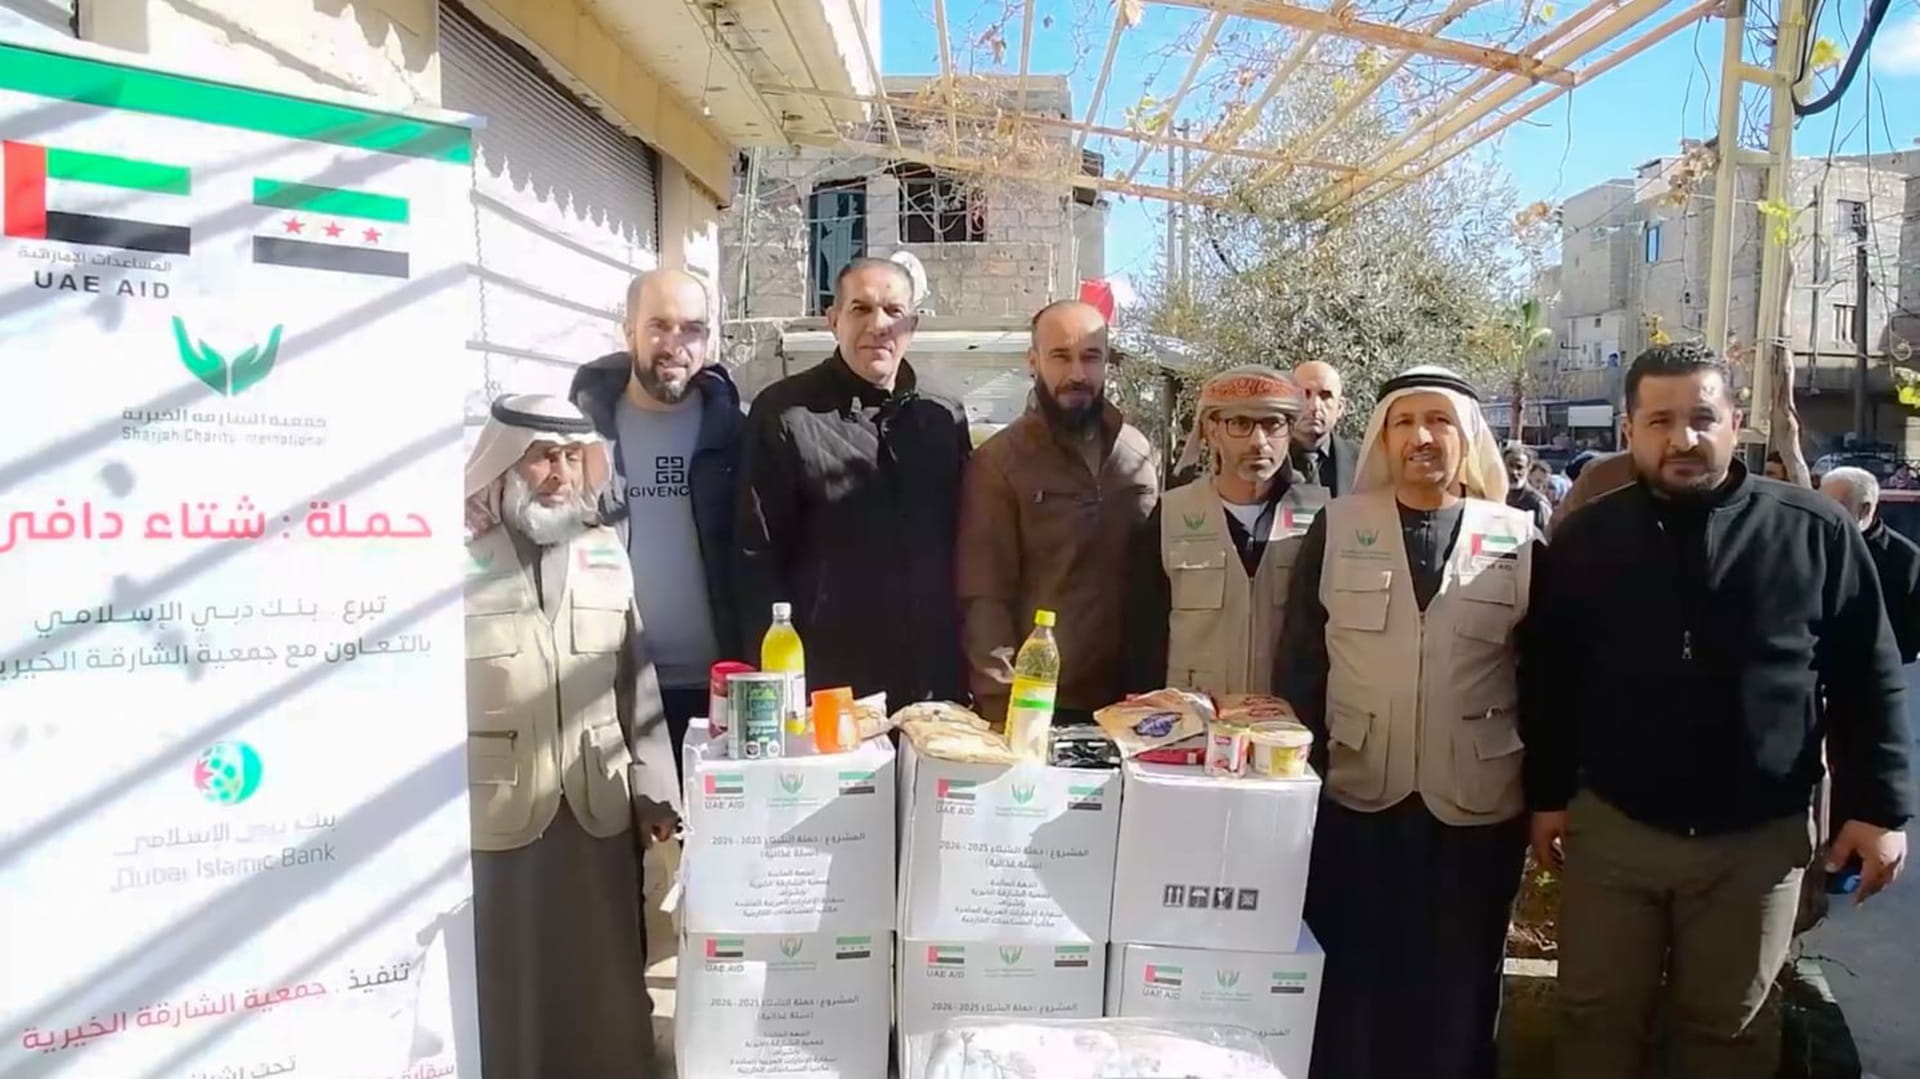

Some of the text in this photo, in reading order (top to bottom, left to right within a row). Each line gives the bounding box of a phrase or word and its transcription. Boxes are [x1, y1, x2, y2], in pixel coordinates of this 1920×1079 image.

[34, 270, 170, 299] UAE AID
[121, 425, 179, 443] Sharjah
[630, 485, 690, 498] GIVENC
[143, 494, 267, 539] شتاء
[305, 500, 433, 539] حملة
[34, 601, 183, 639] الإسلامي
[191, 604, 254, 633] دبي
[260, 597, 318, 622] بنك
[342, 595, 387, 624] تبرع
[86, 641, 188, 673] الشارقة
[196, 642, 278, 669] جمعية
[285, 642, 317, 668] مع
[324, 634, 431, 663] بالتعاون
[704, 801, 726, 810] UAE
[936, 805, 975, 816] UAE AID
[110, 842, 336, 893] Dubai Islamic Bank
[347, 961, 411, 993] تنفيذ
[705, 964, 744, 973] UAE AID
[926, 969, 965, 979] UAE AID
[243, 981, 327, 1013] جمعية
[1142, 988, 1181, 999] UAE AID
[136, 992, 236, 1028] الشارقة
[22, 1011, 127, 1054] الخيرية
